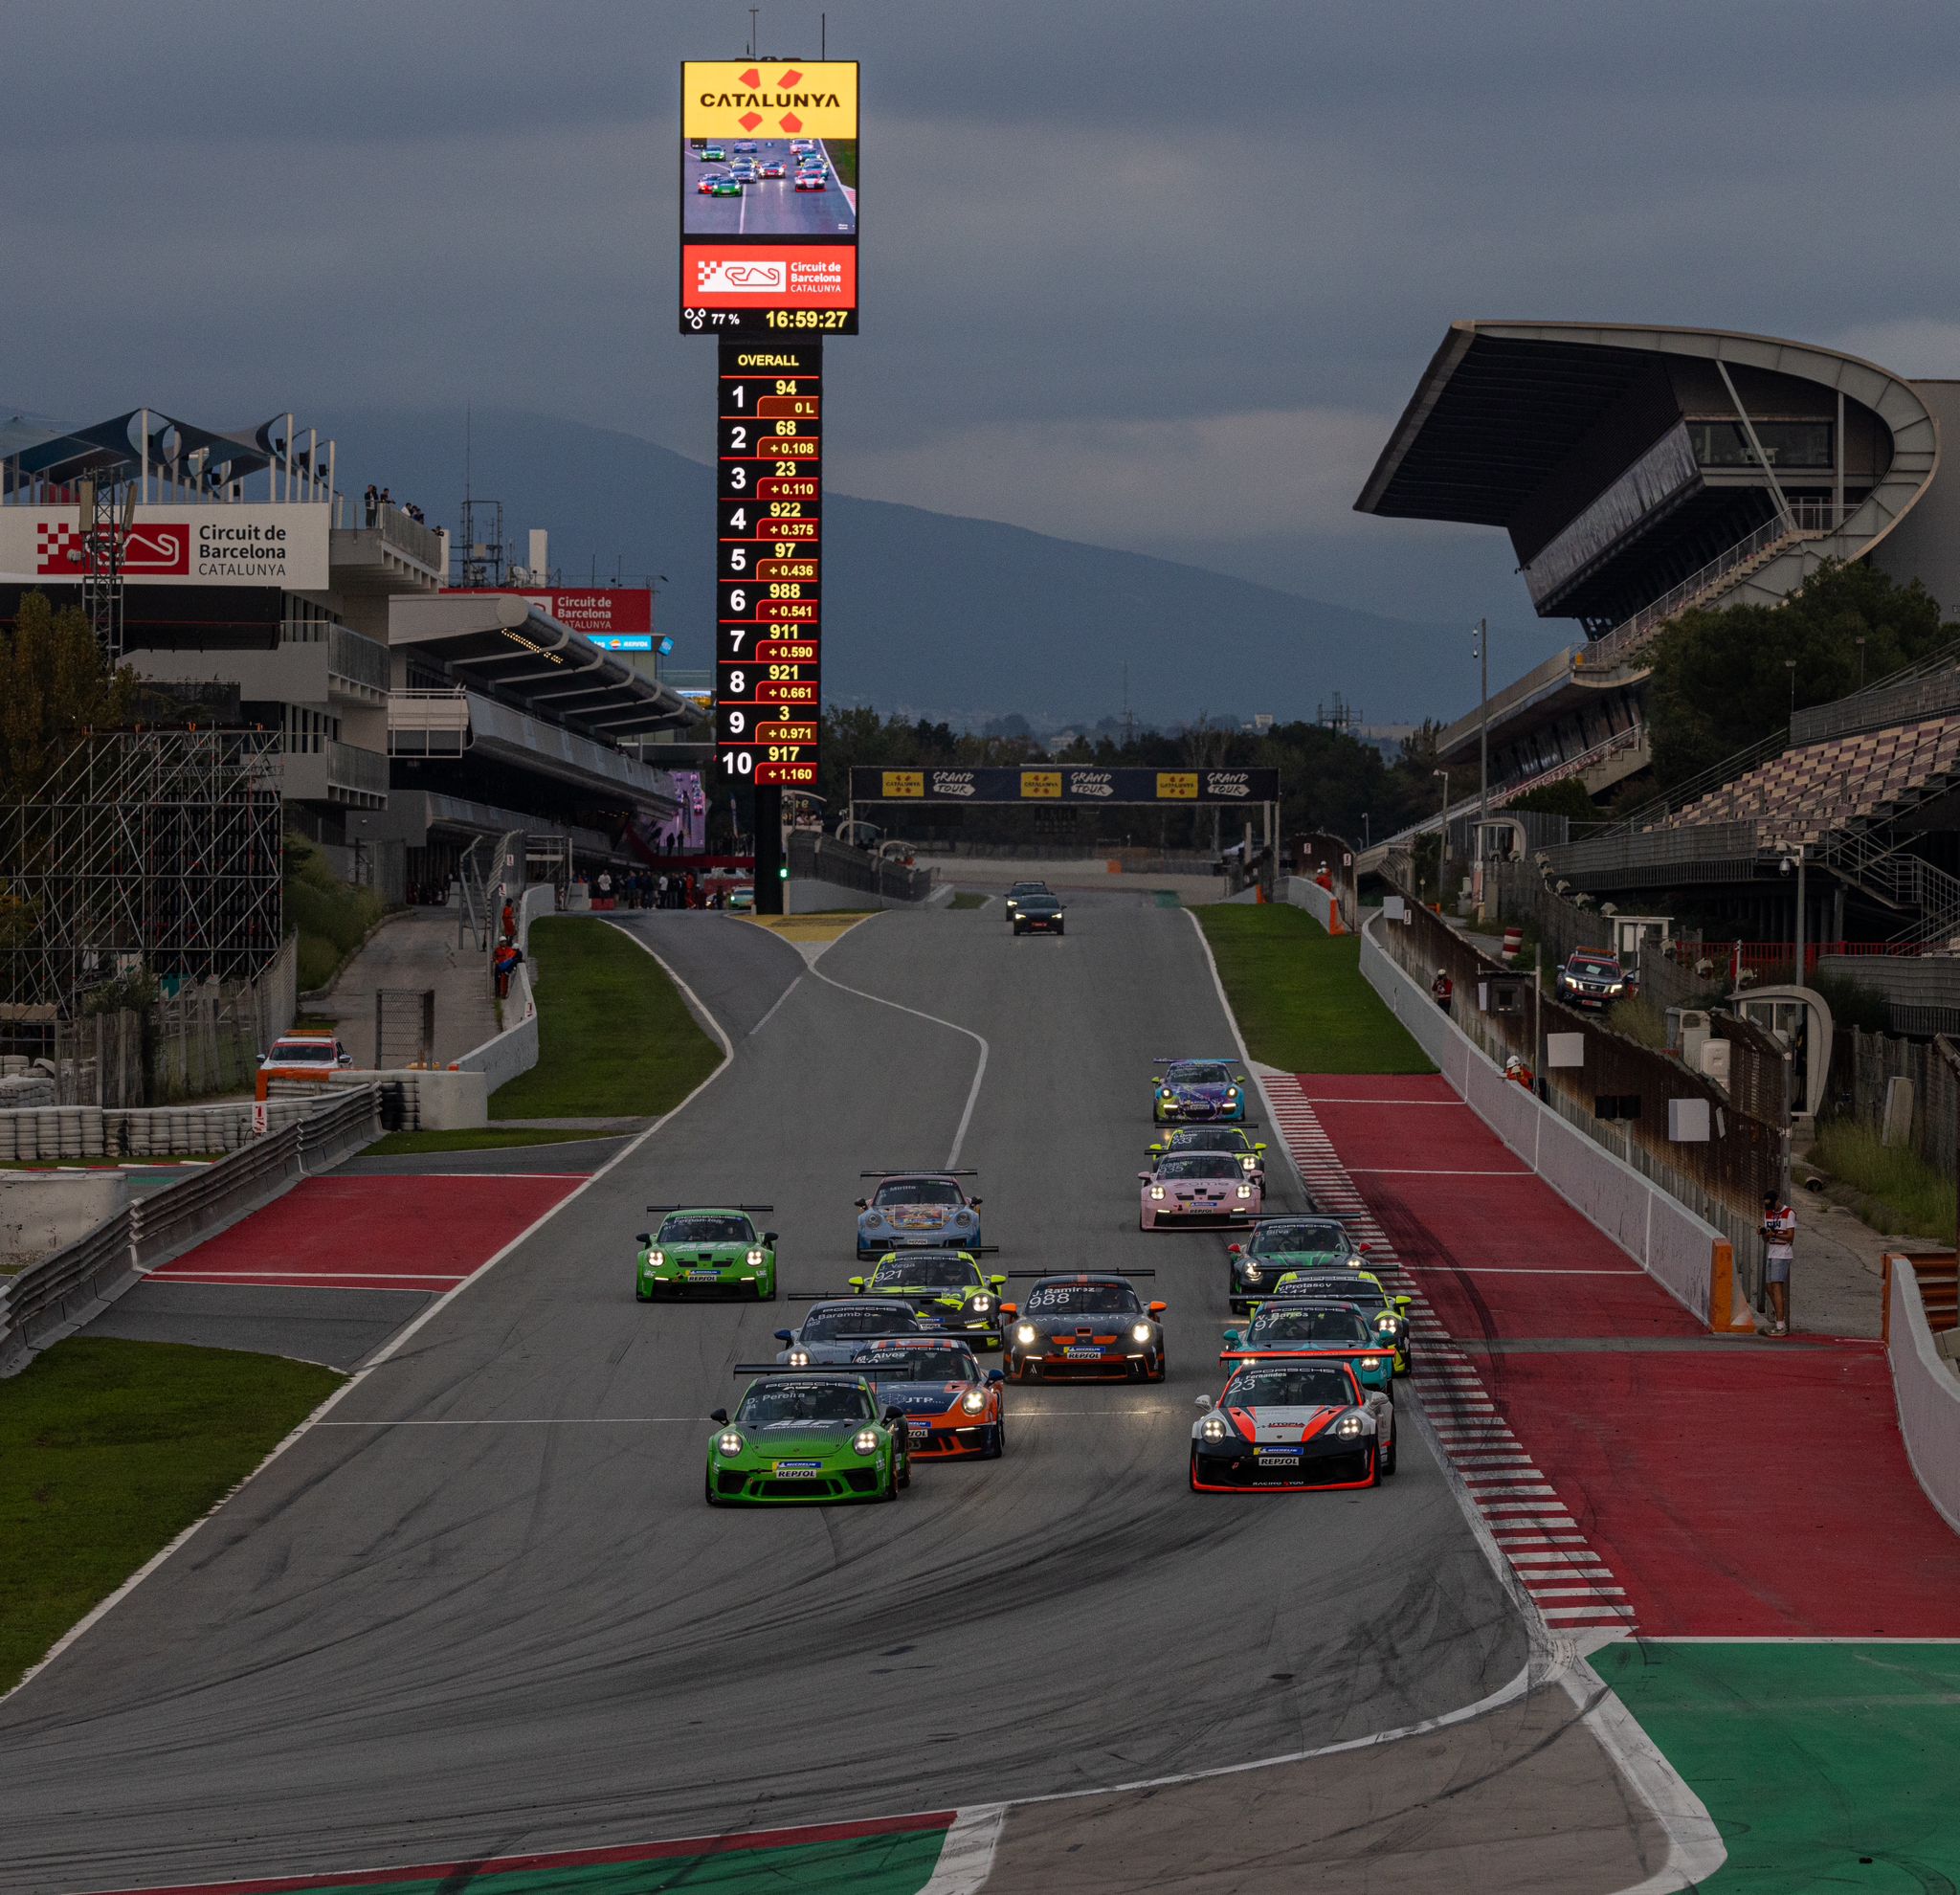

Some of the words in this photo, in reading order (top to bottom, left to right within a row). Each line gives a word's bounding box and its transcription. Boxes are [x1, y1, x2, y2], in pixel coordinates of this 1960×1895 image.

[700, 93, 840, 108] CATALUNYA
[791, 262, 826, 272] Circuit
[828, 262, 841, 272] de
[791, 273, 841, 282] Barcelona
[791, 284, 841, 293] CATALUNYA
[711, 314, 725, 324] 77
[728, 314, 740, 325] %
[766, 311, 848, 328] 16:59:27
[738, 354, 799, 367] OVERALL
[775, 380, 796, 395] 94
[732, 385, 744, 408] 1
[795, 403, 802, 413] 0
[806, 403, 814, 413] L
[775, 421, 796, 435] 68
[731, 426, 746, 449] 2
[775, 461, 796, 477] 23
[731, 467, 746, 489] 3
[770, 502, 801, 518] 922
[730, 507, 746, 529] 4
[199, 524, 261, 541] Circuit
[265, 525, 286, 541] de
[199, 545, 286, 559] Barcelona
[775, 543, 796, 558] 97
[730, 548, 746, 570] 5
[198, 563, 286, 576] CATALUNYA
[769, 584, 801, 599] 988
[558, 596, 596, 607] Circuit
[597, 597, 612, 607] de
[730, 589, 746, 611] 6
[558, 609, 612, 619] Barcelona
[563, 620, 612, 629] ATALUNYA
[769, 624, 799, 639] 911
[730, 630, 746, 652] 7
[769, 665, 799, 680] 921
[729, 670, 745, 693] 8
[779, 705, 790, 721] 3
[729, 711, 745, 733] 9
[768, 747, 799, 762] 917
[723, 751, 752, 774] 10
[933, 771, 974, 783] GRAND
[1071, 771, 1112, 783] GRAND
[1207, 772, 1248, 784] GRAND
[938, 784, 969, 794] TOUR
[1076, 785, 1106, 794] TOUR
[1213, 785, 1243, 794] TOUR
[875, 1269, 902, 1282] 921
[1029, 1292, 1070, 1308] 988
[1255, 1317, 1279, 1331] 97
[1229, 1378, 1256, 1394] 23
